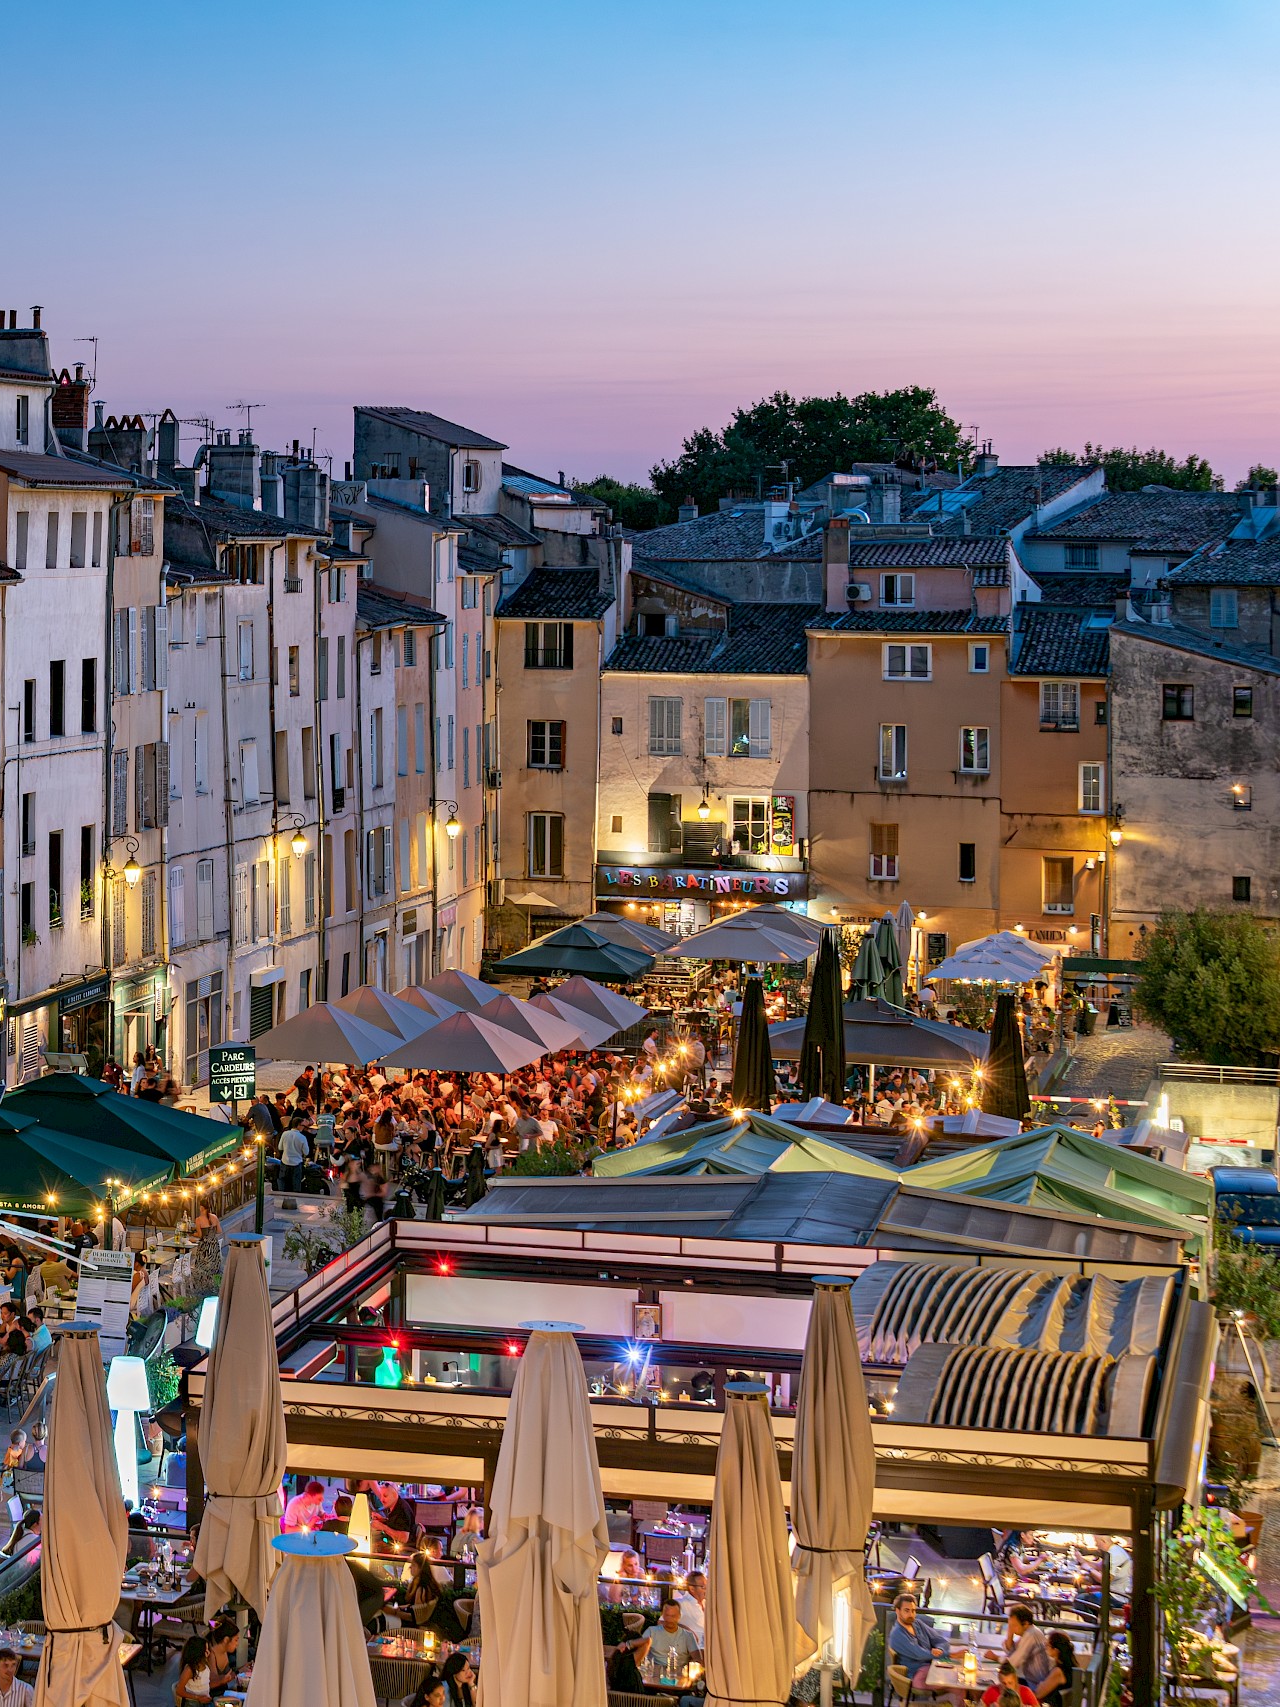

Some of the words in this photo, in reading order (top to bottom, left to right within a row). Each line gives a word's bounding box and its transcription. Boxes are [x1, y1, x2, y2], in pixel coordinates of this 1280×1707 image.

[605, 869, 642, 888] LES
[221, 1051, 245, 1061] PARC
[211, 1062, 255, 1073] CARDEURS
[21, 1203, 46, 1211] AMORE
